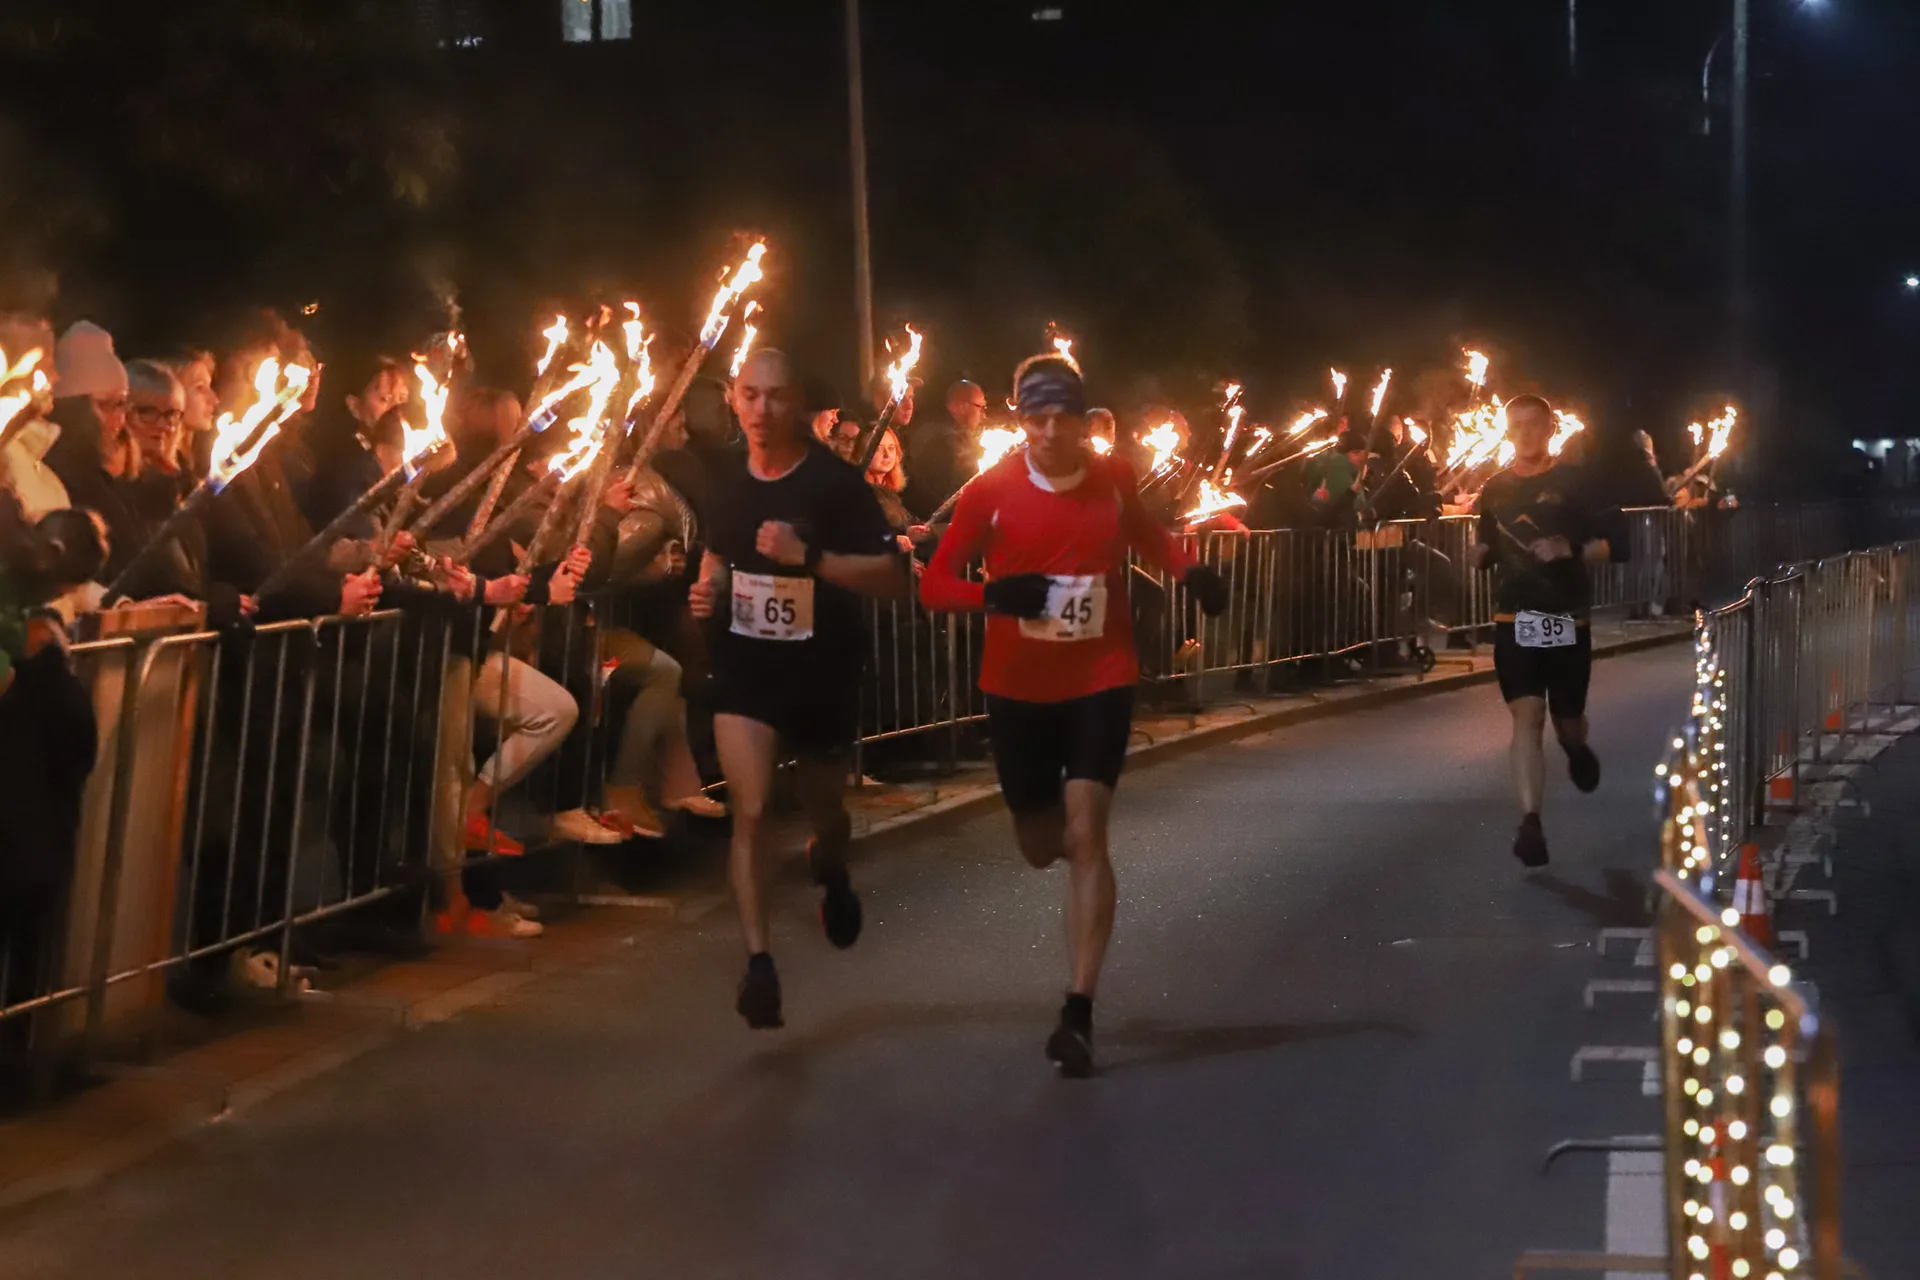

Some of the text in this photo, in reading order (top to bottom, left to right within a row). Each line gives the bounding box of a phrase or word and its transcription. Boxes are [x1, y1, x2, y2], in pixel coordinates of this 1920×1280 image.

[764, 597, 796, 625] 65
[1060, 597, 1092, 625] 45
[1541, 617, 1564, 637] 95
